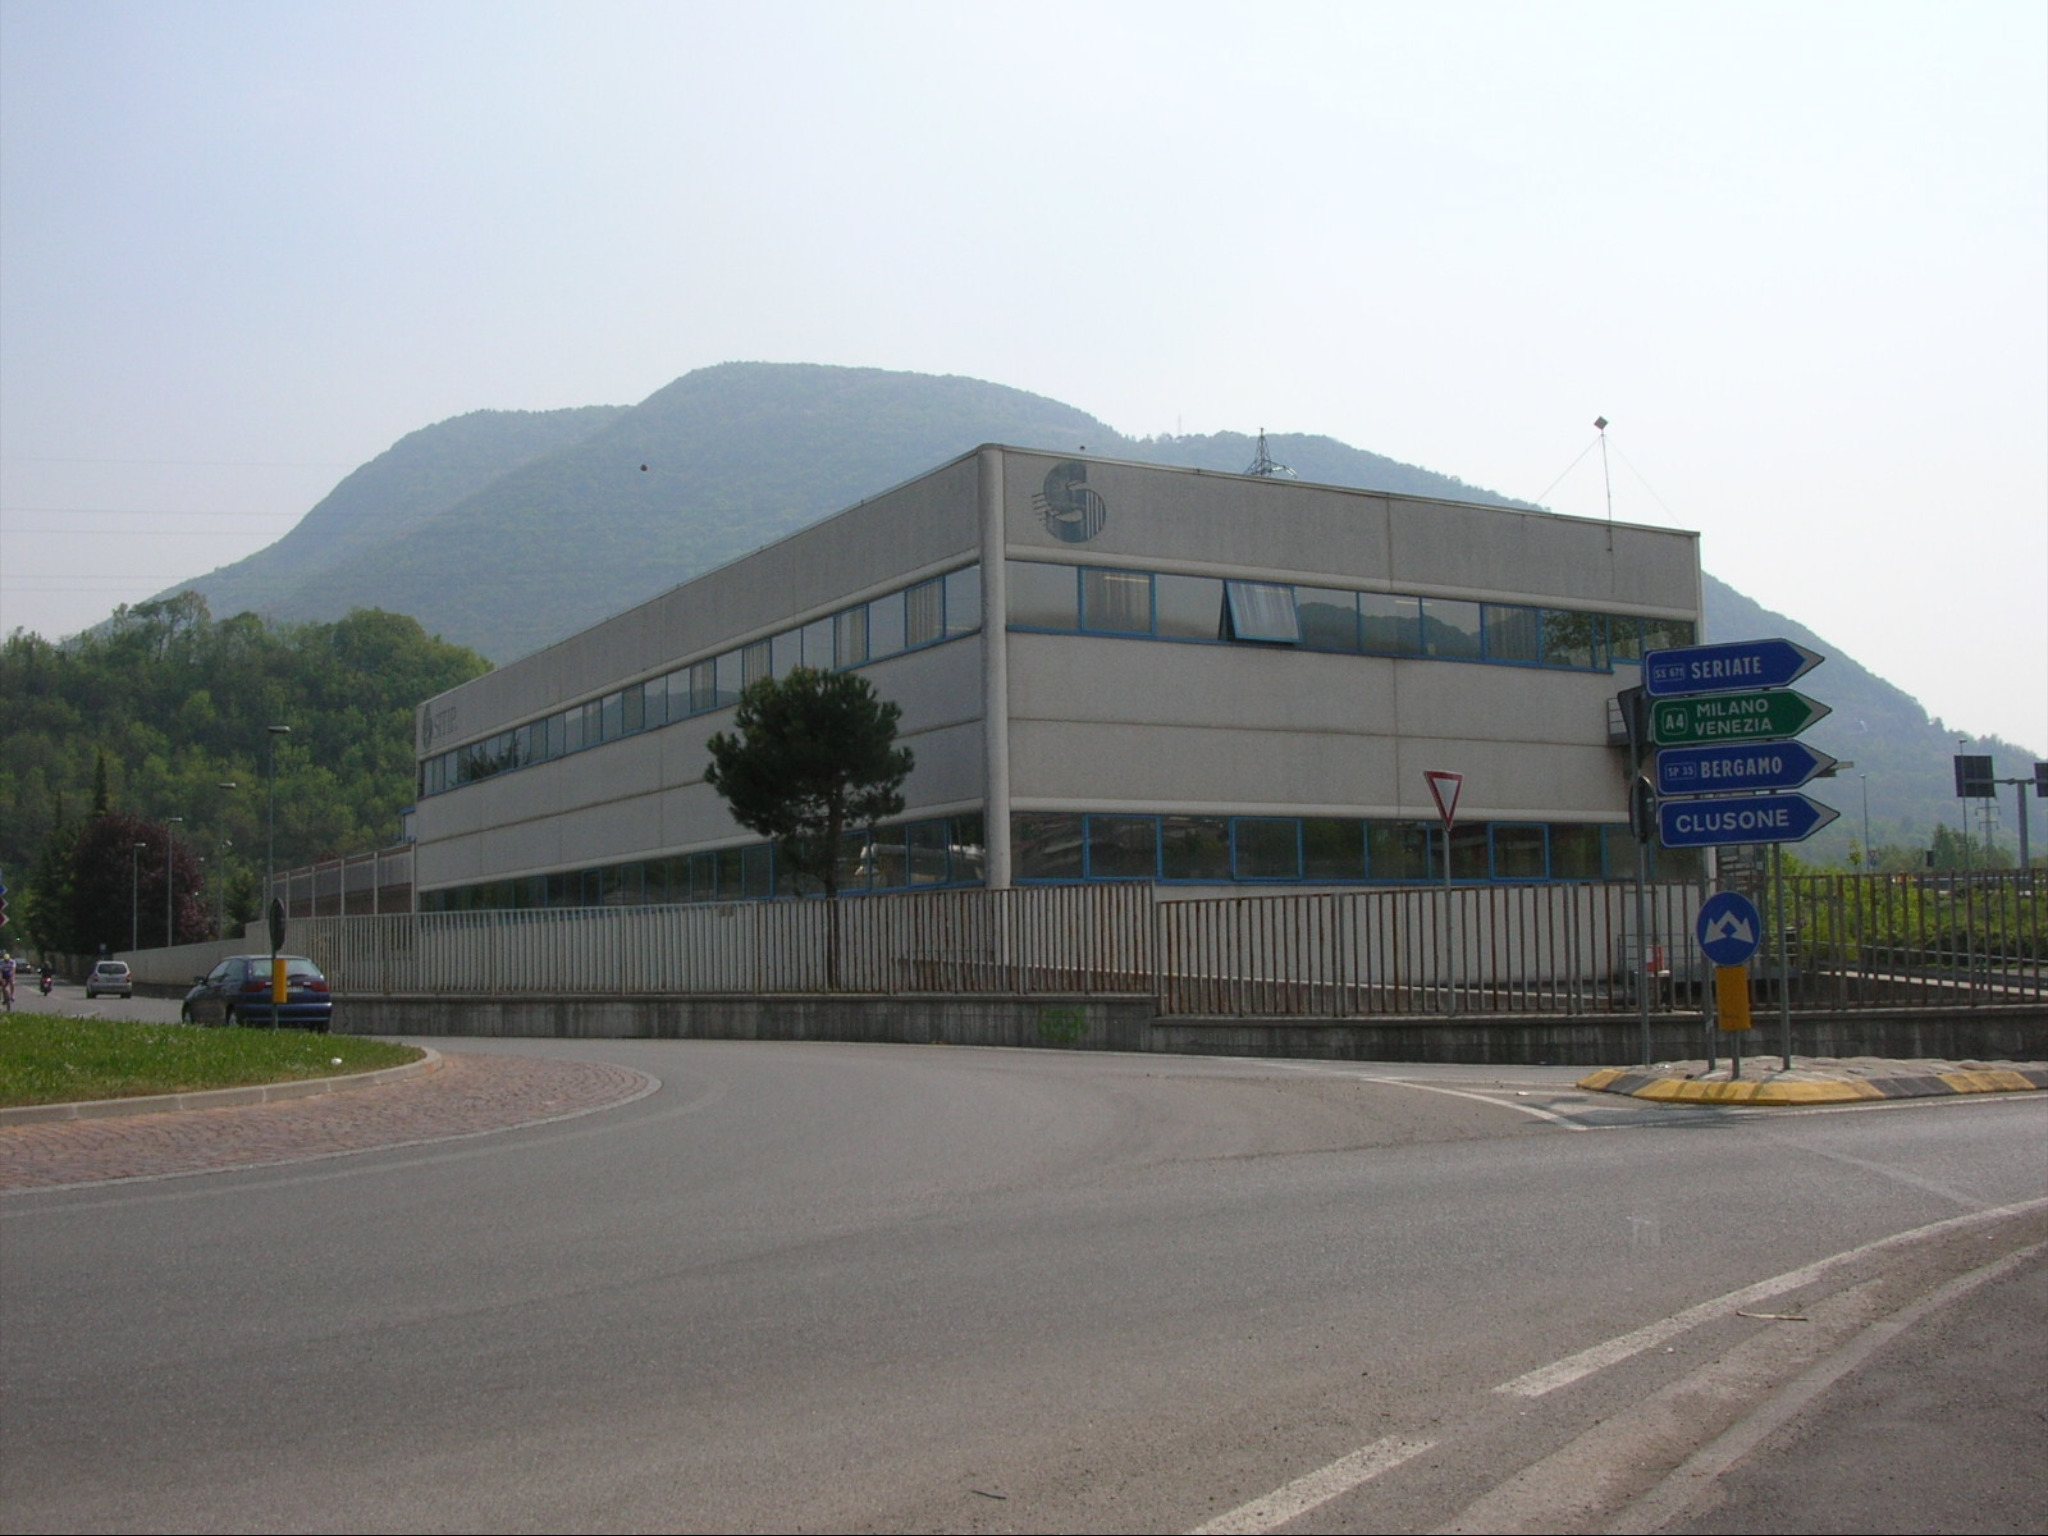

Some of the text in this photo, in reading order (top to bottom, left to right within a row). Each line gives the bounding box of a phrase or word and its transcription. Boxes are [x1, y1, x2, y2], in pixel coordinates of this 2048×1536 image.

[1691, 657, 1761, 679] SERIATE
[1697, 699, 1768, 717] MILANO
[1665, 714, 1684, 730] A4
[1694, 718, 1772, 736] VENEZIA
[1700, 757, 1783, 779] BERGAMO
[1676, 810, 1789, 833] CLUSONE
